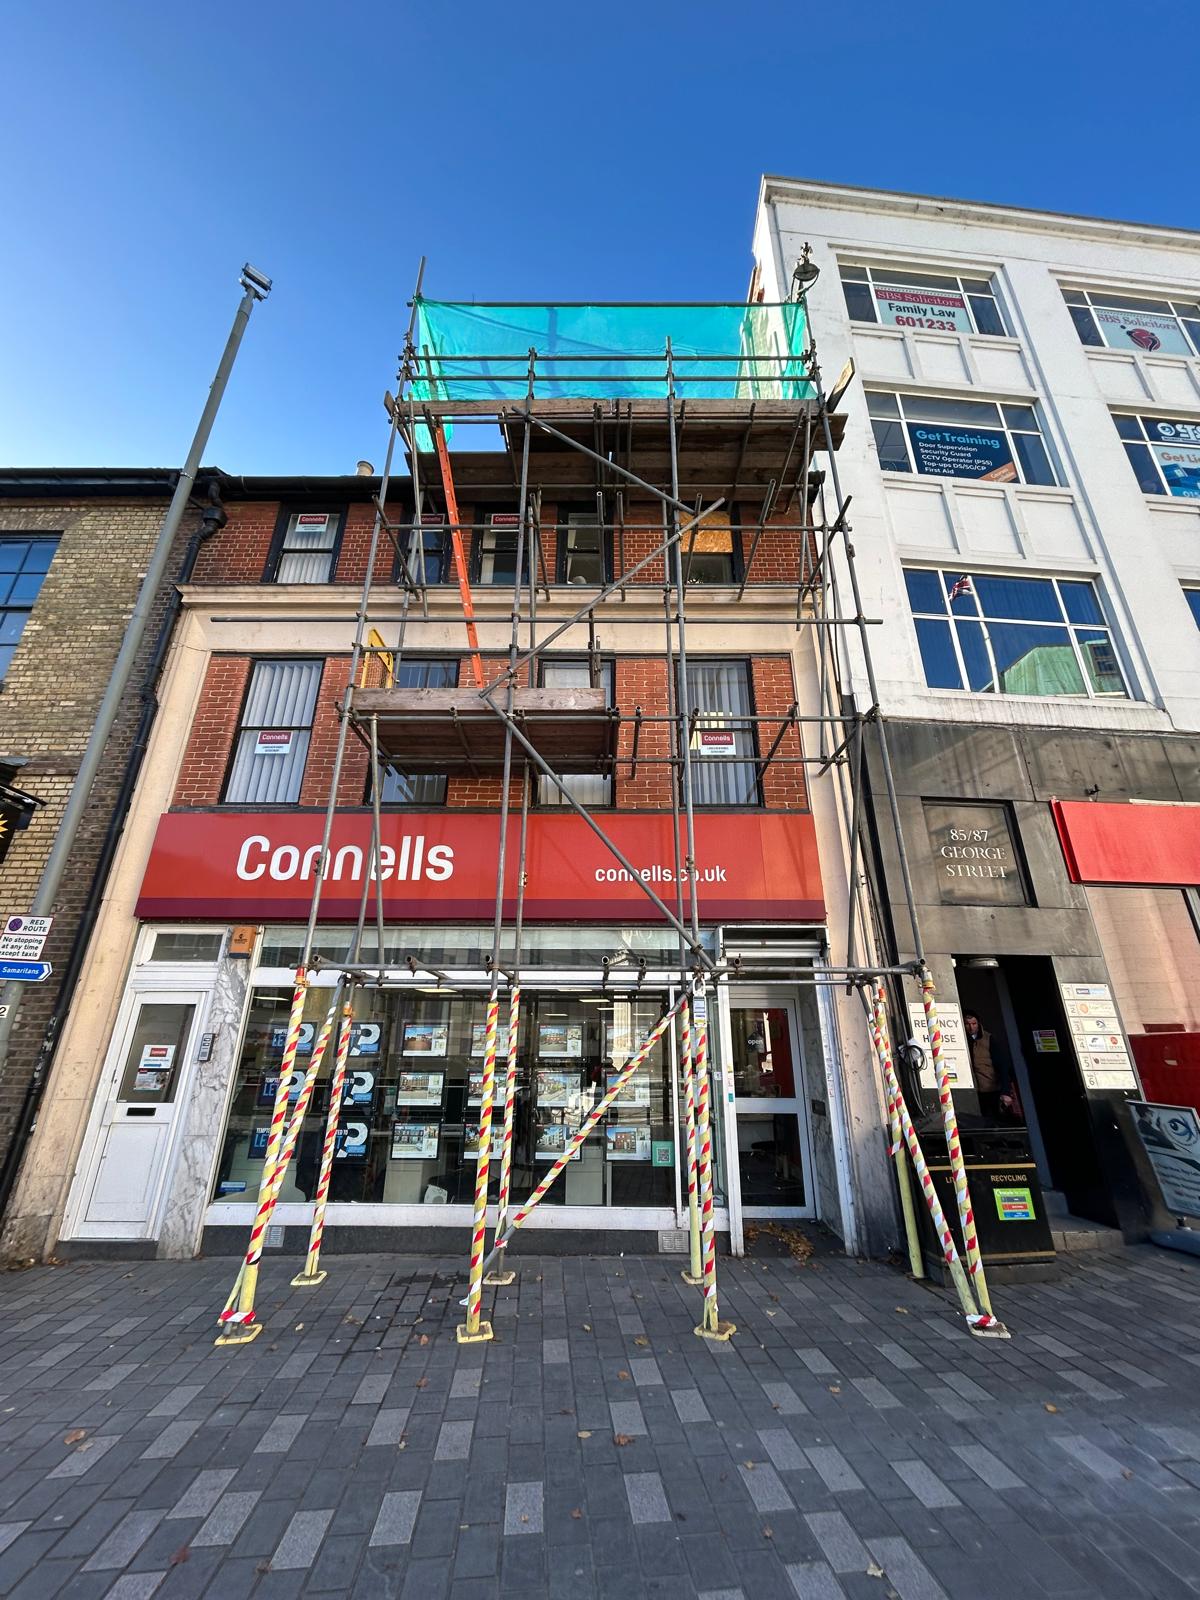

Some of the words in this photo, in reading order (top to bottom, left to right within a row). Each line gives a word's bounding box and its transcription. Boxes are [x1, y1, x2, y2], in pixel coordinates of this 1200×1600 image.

[877, 291, 902, 300] SBS
[904, 294, 961, 307] Solicitors
[888, 303, 927, 316] Family
[931, 307, 956, 318] Law
[896, 315, 956, 331] 601233
[1098, 314, 1121, 323] SBS
[1123, 316, 1178, 330] Solicitors
[916, 430, 941, 441] Get
[943, 433, 1000, 449] Training
[920, 448, 949, 456] Security
[937, 444, 978, 452] Supervision
[942, 456, 973, 464] Operator
[1161, 452, 1185, 462] Get
[923, 460, 952, 468] Top-ups
[950, 828, 988, 841] 85/87
[236, 835, 454, 881] Connells
[941, 846, 1007, 860] GEORGE
[946, 864, 1008, 878] STREET
[14, 937, 43, 945] stopping
[2, 966, 40, 974] Samaritans
[914, 1019, 959, 1028] RENCY
[922, 1034, 957, 1042] HSE
[991, 1174, 1027, 1182] RECYCLING
